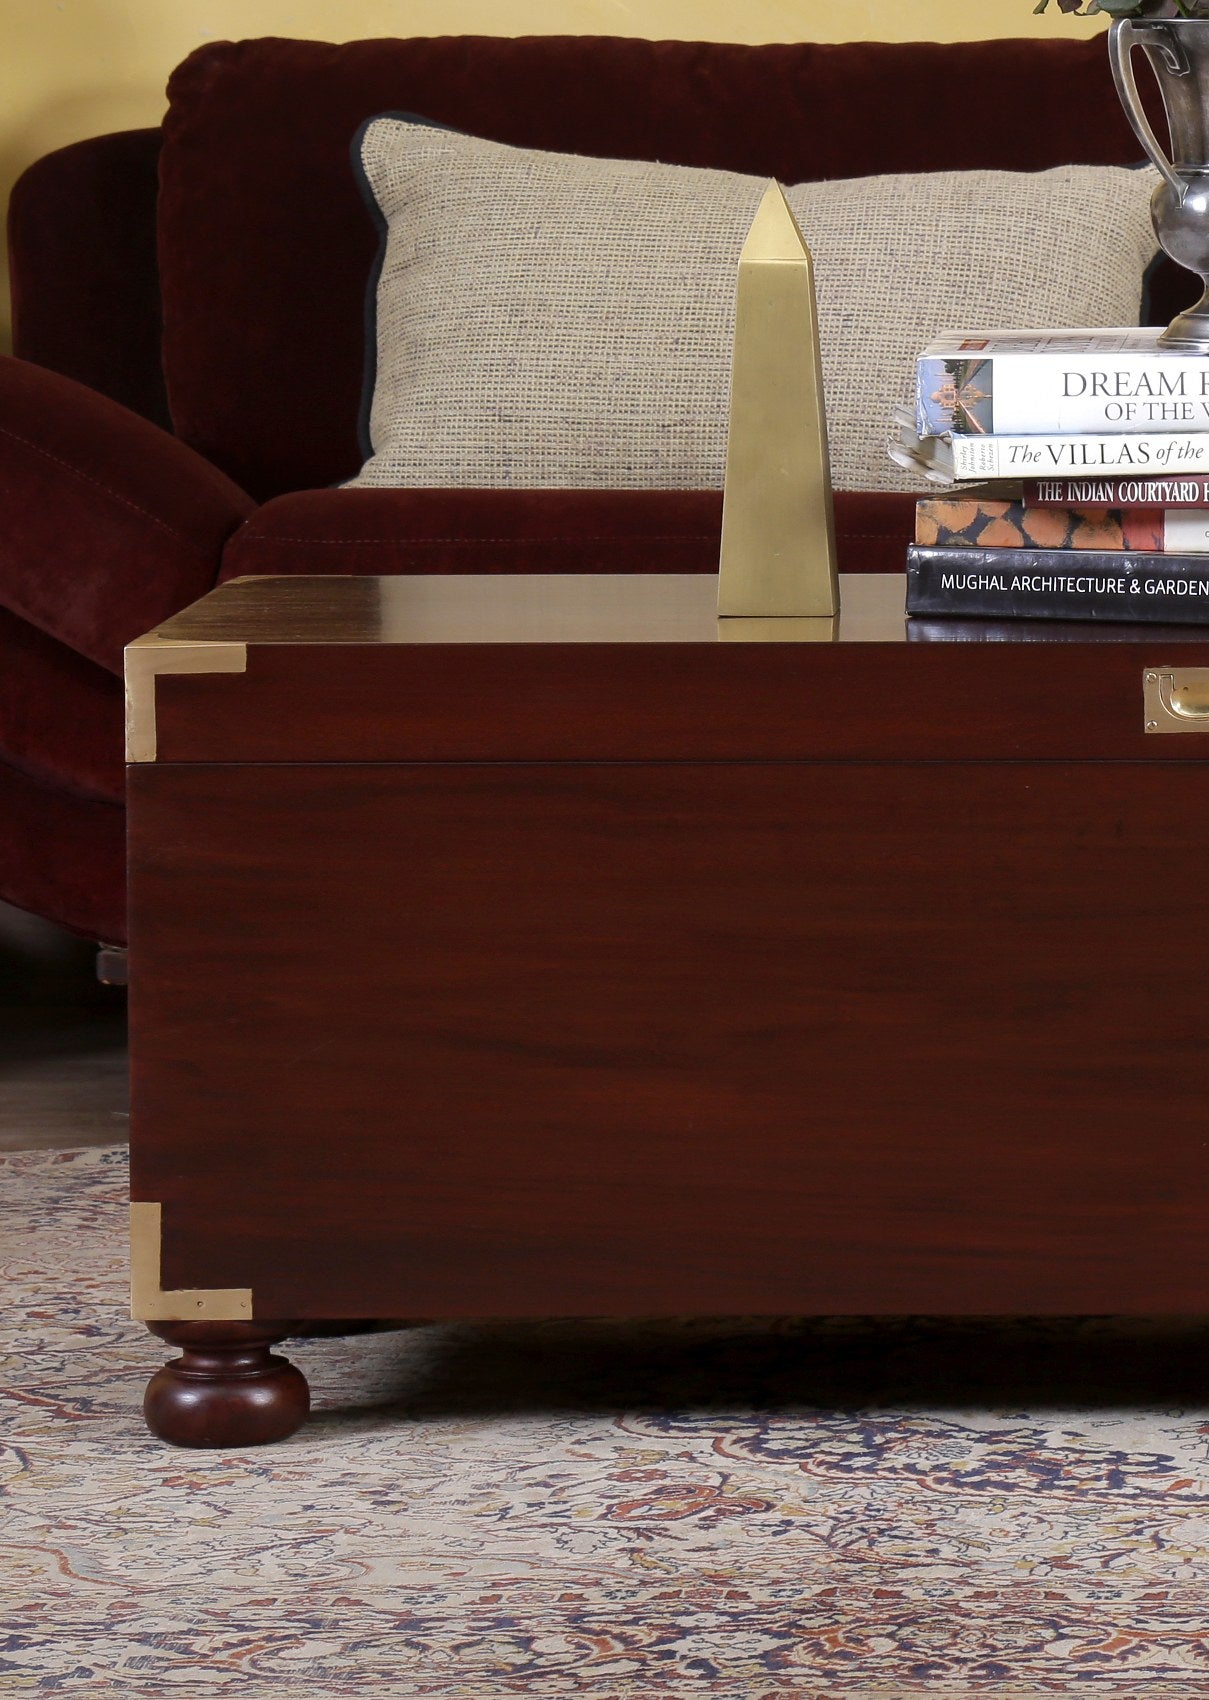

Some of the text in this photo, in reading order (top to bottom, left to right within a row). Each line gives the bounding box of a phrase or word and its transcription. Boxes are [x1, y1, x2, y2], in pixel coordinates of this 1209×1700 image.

[1062, 371, 1187, 397] DREAM
[1104, 402, 1138, 421] OF
[1143, 401, 1195, 421] THE
[1008, 444, 1042, 464] The
[1046, 441, 1151, 466] VILLAS
[1155, 440, 1178, 466] of
[1177, 440, 1204, 460] the
[1036, 481, 1062, 501] THE
[1066, 481, 1114, 502] INDIAN
[1118, 481, 1200, 502] COURTYARD
[941, 573, 1008, 591] MUGHAL
[1010, 575, 1126, 594] ARCHITECTURE
[1129, 578, 1142, 594] &
